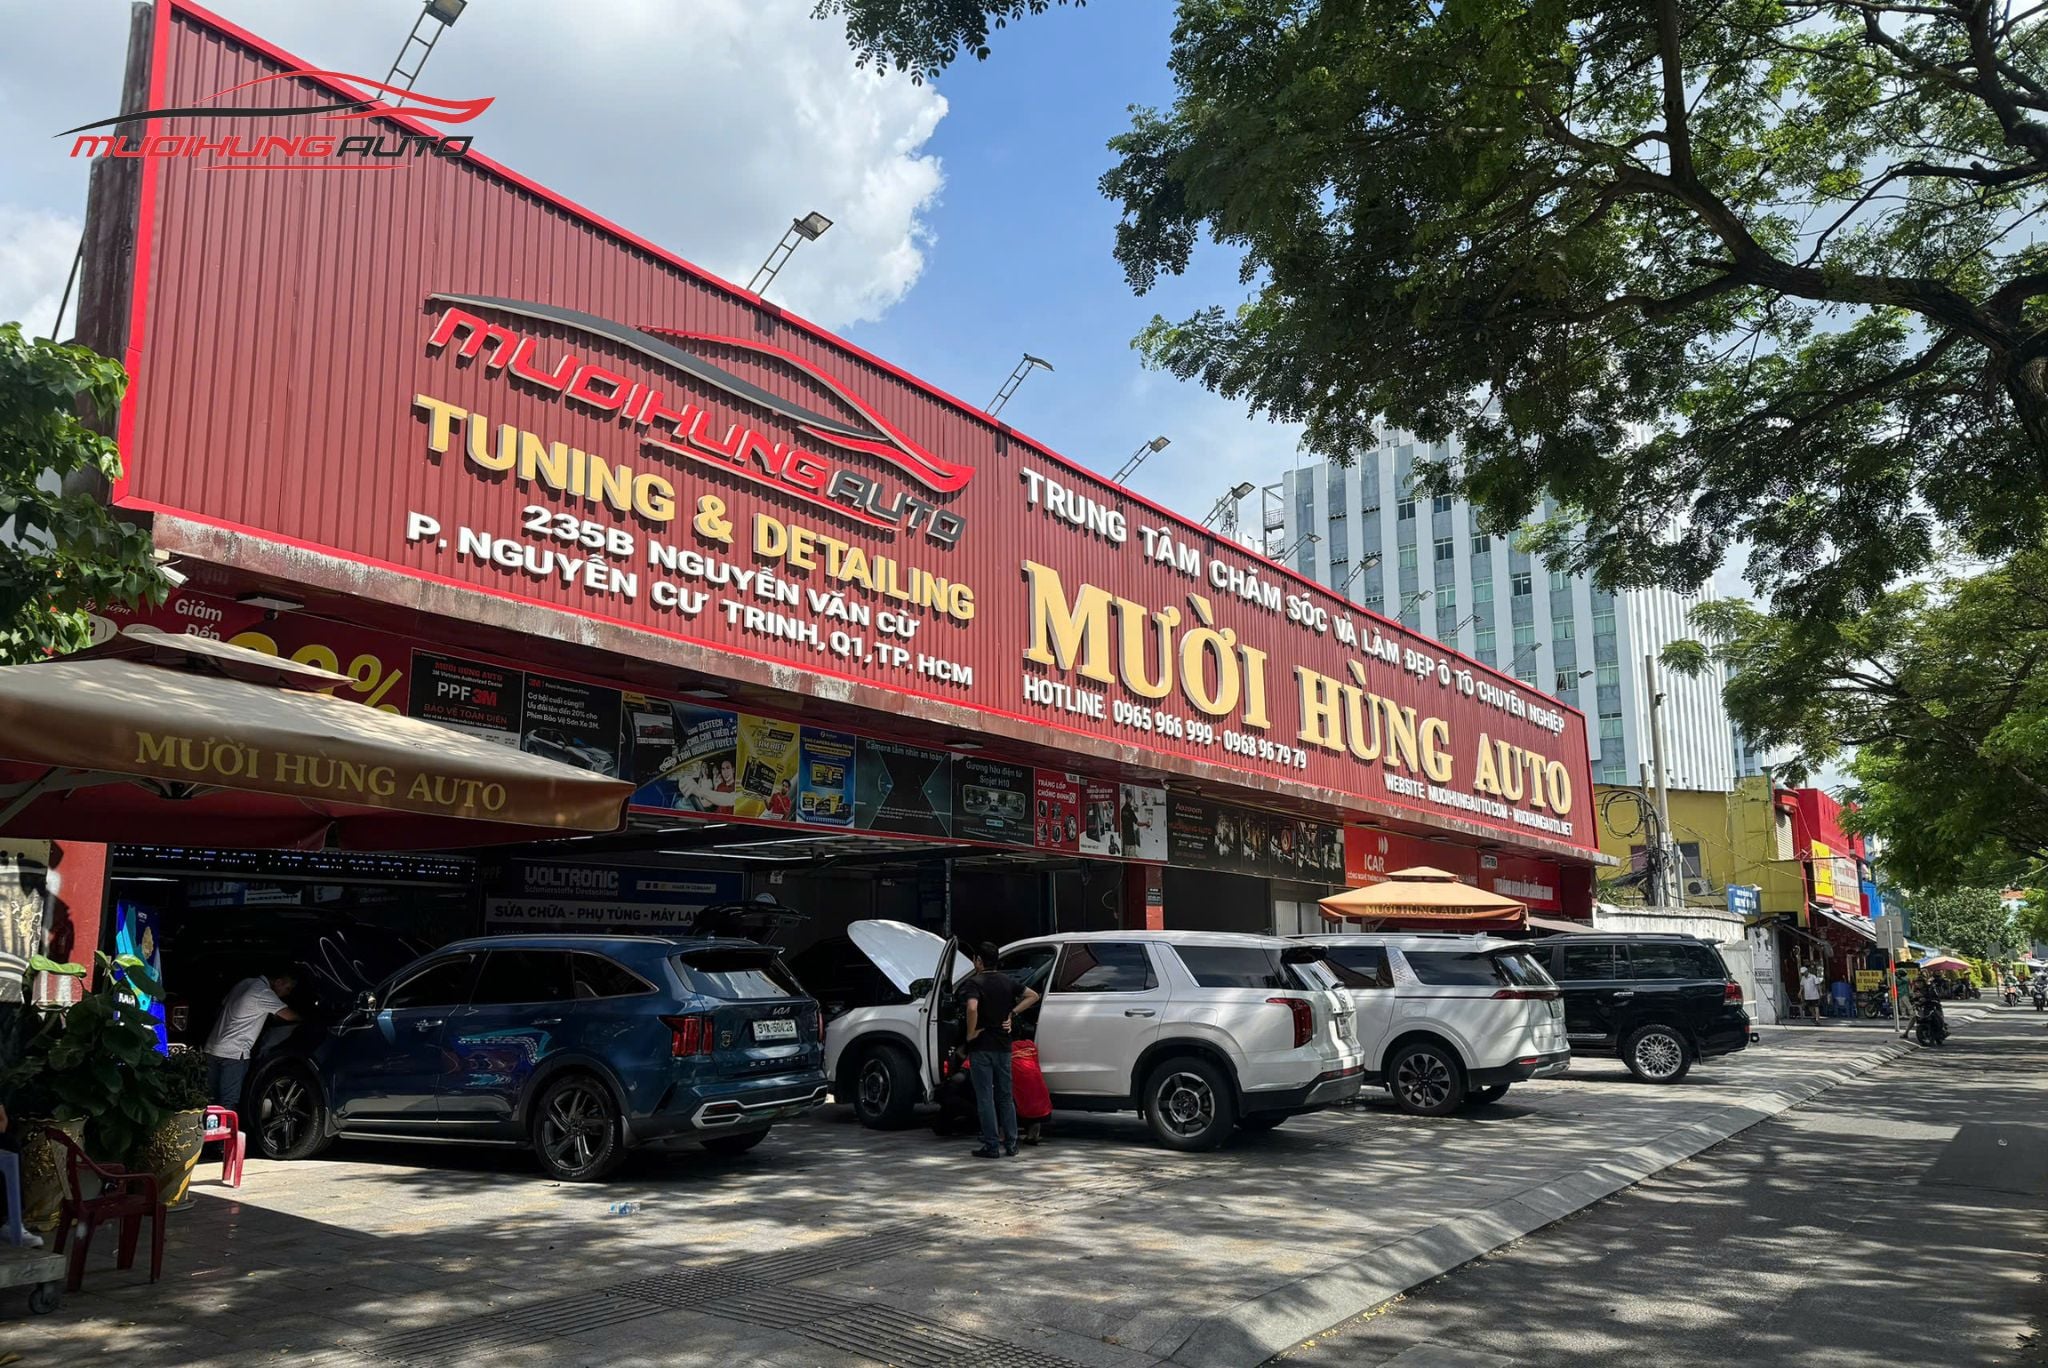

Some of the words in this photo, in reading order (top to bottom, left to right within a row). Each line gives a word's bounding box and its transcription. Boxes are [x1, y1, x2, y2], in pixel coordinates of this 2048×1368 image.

[413, 393, 675, 521] TUNING
[693, 494, 734, 543] &
[753, 512, 975, 620] DETAILING
[407, 511, 448, 548] P.
[457, 526, 638, 598] NGUYỄN
[651, 581, 710, 614] CƯ
[522, 505, 634, 557] 235B
[648, 539, 799, 605] NGUYỄN
[807, 588, 870, 626] VĂN
[876, 609, 920, 638] CỪ
[175, 598, 222, 621] Giảm
[1021, 467, 1127, 543] TRUNG
[1140, 527, 1200, 577] TÂM
[1209, 560, 1281, 612] CHĂM
[1286, 592, 1328, 633] SÓC
[1331, 612, 1358, 647] VÀ
[1361, 627, 1400, 665] LÀM
[1403, 647, 1435, 680] ĐẸP
[1437, 659, 1451, 685] Ô
[1455, 669, 1475, 696] TÔ
[1477, 680, 1526, 718] CHUYÊN
[1527, 703, 1565, 737] NGHIỆP
[186, 623, 221, 641] Đến
[437, 681, 471, 701] PPF
[472, 688, 497, 706] 3M
[1021, 559, 1271, 729] MƯỜI
[1293, 659, 1453, 782] HÙNG
[1474, 733, 1572, 815] AUTO
[1113, 700, 1152, 730] 0965
[1154, 711, 1181, 738] 966
[1185, 719, 1213, 745] 999
[1223, 729, 1257, 756] 0968
[135, 731, 260, 779] MƯỜI
[274, 750, 396, 796] HÙNG
[407, 772, 507, 811] AUTO
[1364, 853, 1385, 873] ICAR
[524, 865, 620, 889] VOLTRONIC
[494, 900, 524, 917] SỬA
[528, 903, 566, 918] CHỮA
[577, 907, 604, 922] PHỤ
[607, 906, 641, 920] TÙNG
[651, 907, 676, 921] MÁY
[1365, 902, 1398, 916] MƯỜI
[1400, 902, 1438, 917] HÙNG
[1441, 905, 1475, 917] AUTO
[772, 1006, 791, 1015] KIA
